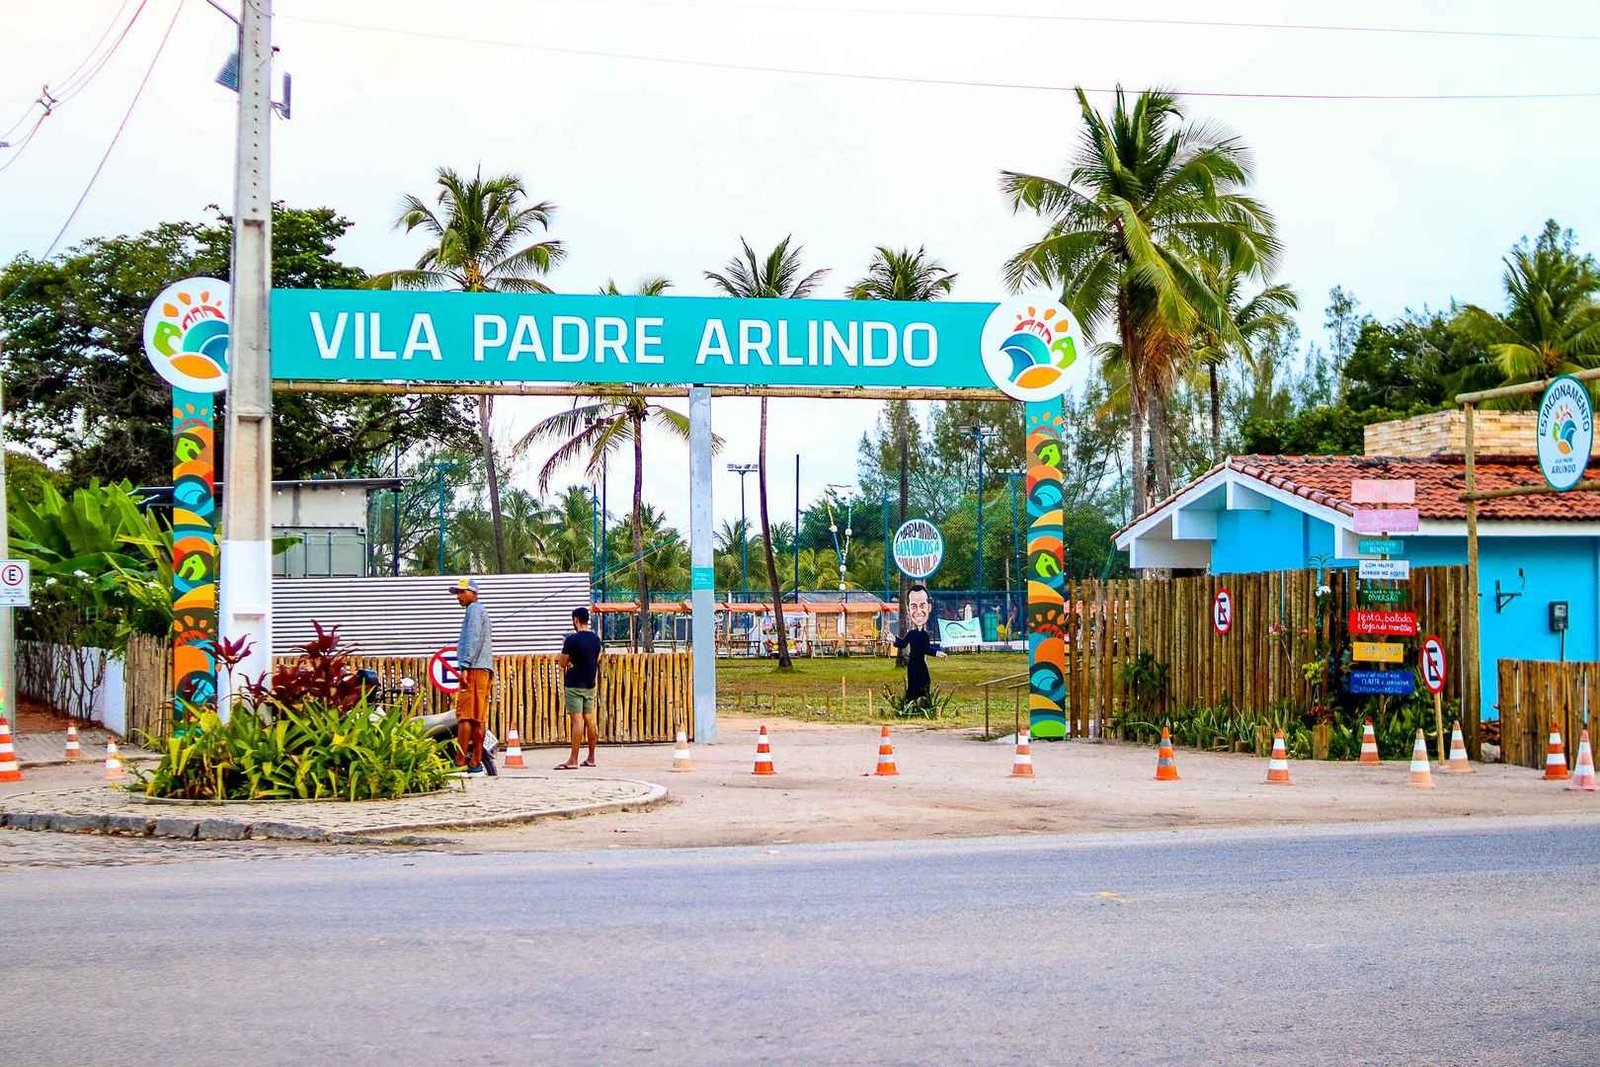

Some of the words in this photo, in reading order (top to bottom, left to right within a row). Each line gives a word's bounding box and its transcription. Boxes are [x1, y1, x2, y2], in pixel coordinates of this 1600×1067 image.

[310, 312, 442, 360] VILA
[474, 314, 665, 364] PADRE
[695, 319, 938, 367] ARLINDO
[1540, 383, 1590, 437] ESTACIONAMENTO
[1551, 464, 1576, 474] ARLINDO
[9, 569, 16, 581] E
[898, 556, 921, 575] MINHA
[1218, 597, 1227, 625] E
[1428, 647, 1438, 681] E
